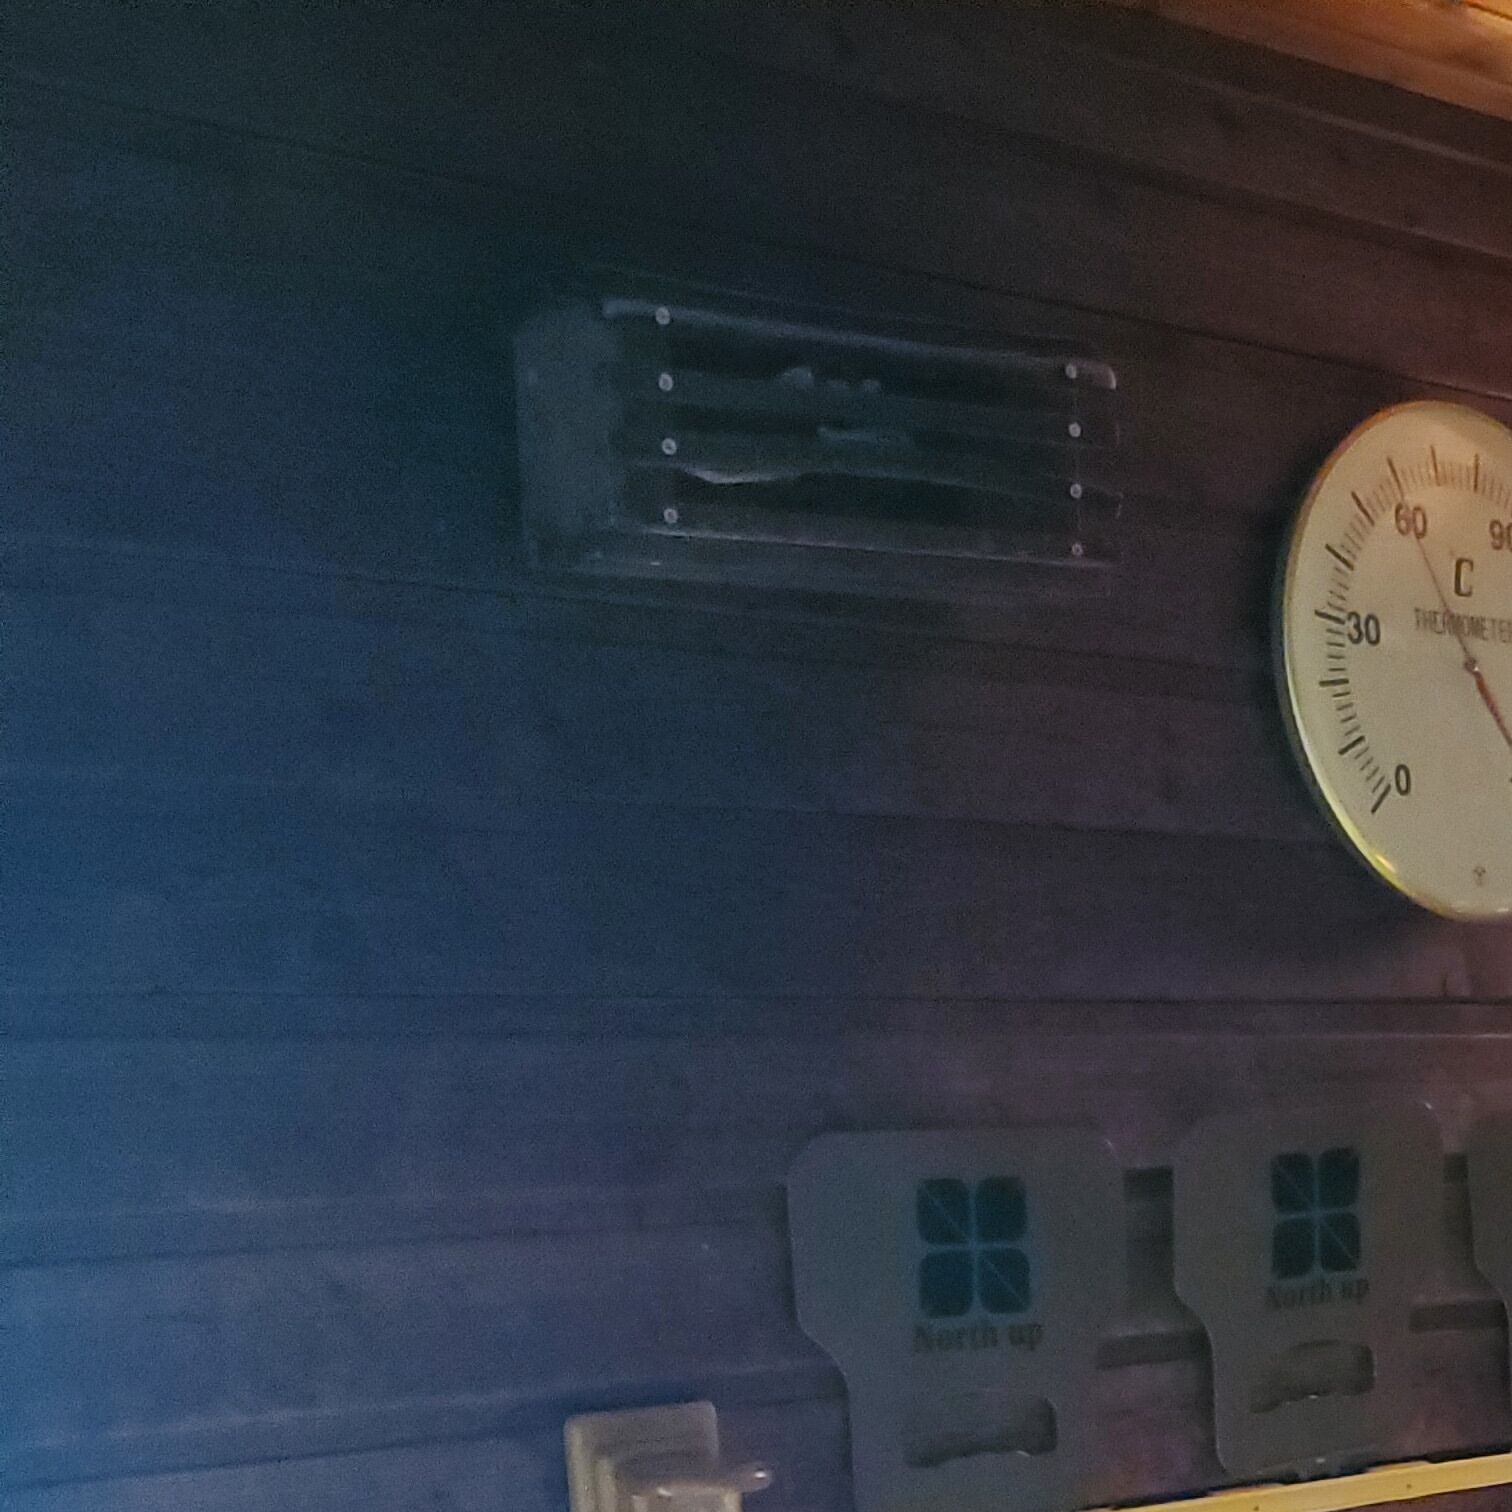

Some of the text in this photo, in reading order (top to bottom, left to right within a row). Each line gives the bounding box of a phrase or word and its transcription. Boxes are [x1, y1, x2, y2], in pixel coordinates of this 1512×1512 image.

[1395, 505, 1428, 539] 60
[1347, 612, 1381, 647] 30
[1395, 763, 1412, 797] 0
[1265, 1277, 1369, 1309] North up
[912, 1318, 1042, 1354] North up
